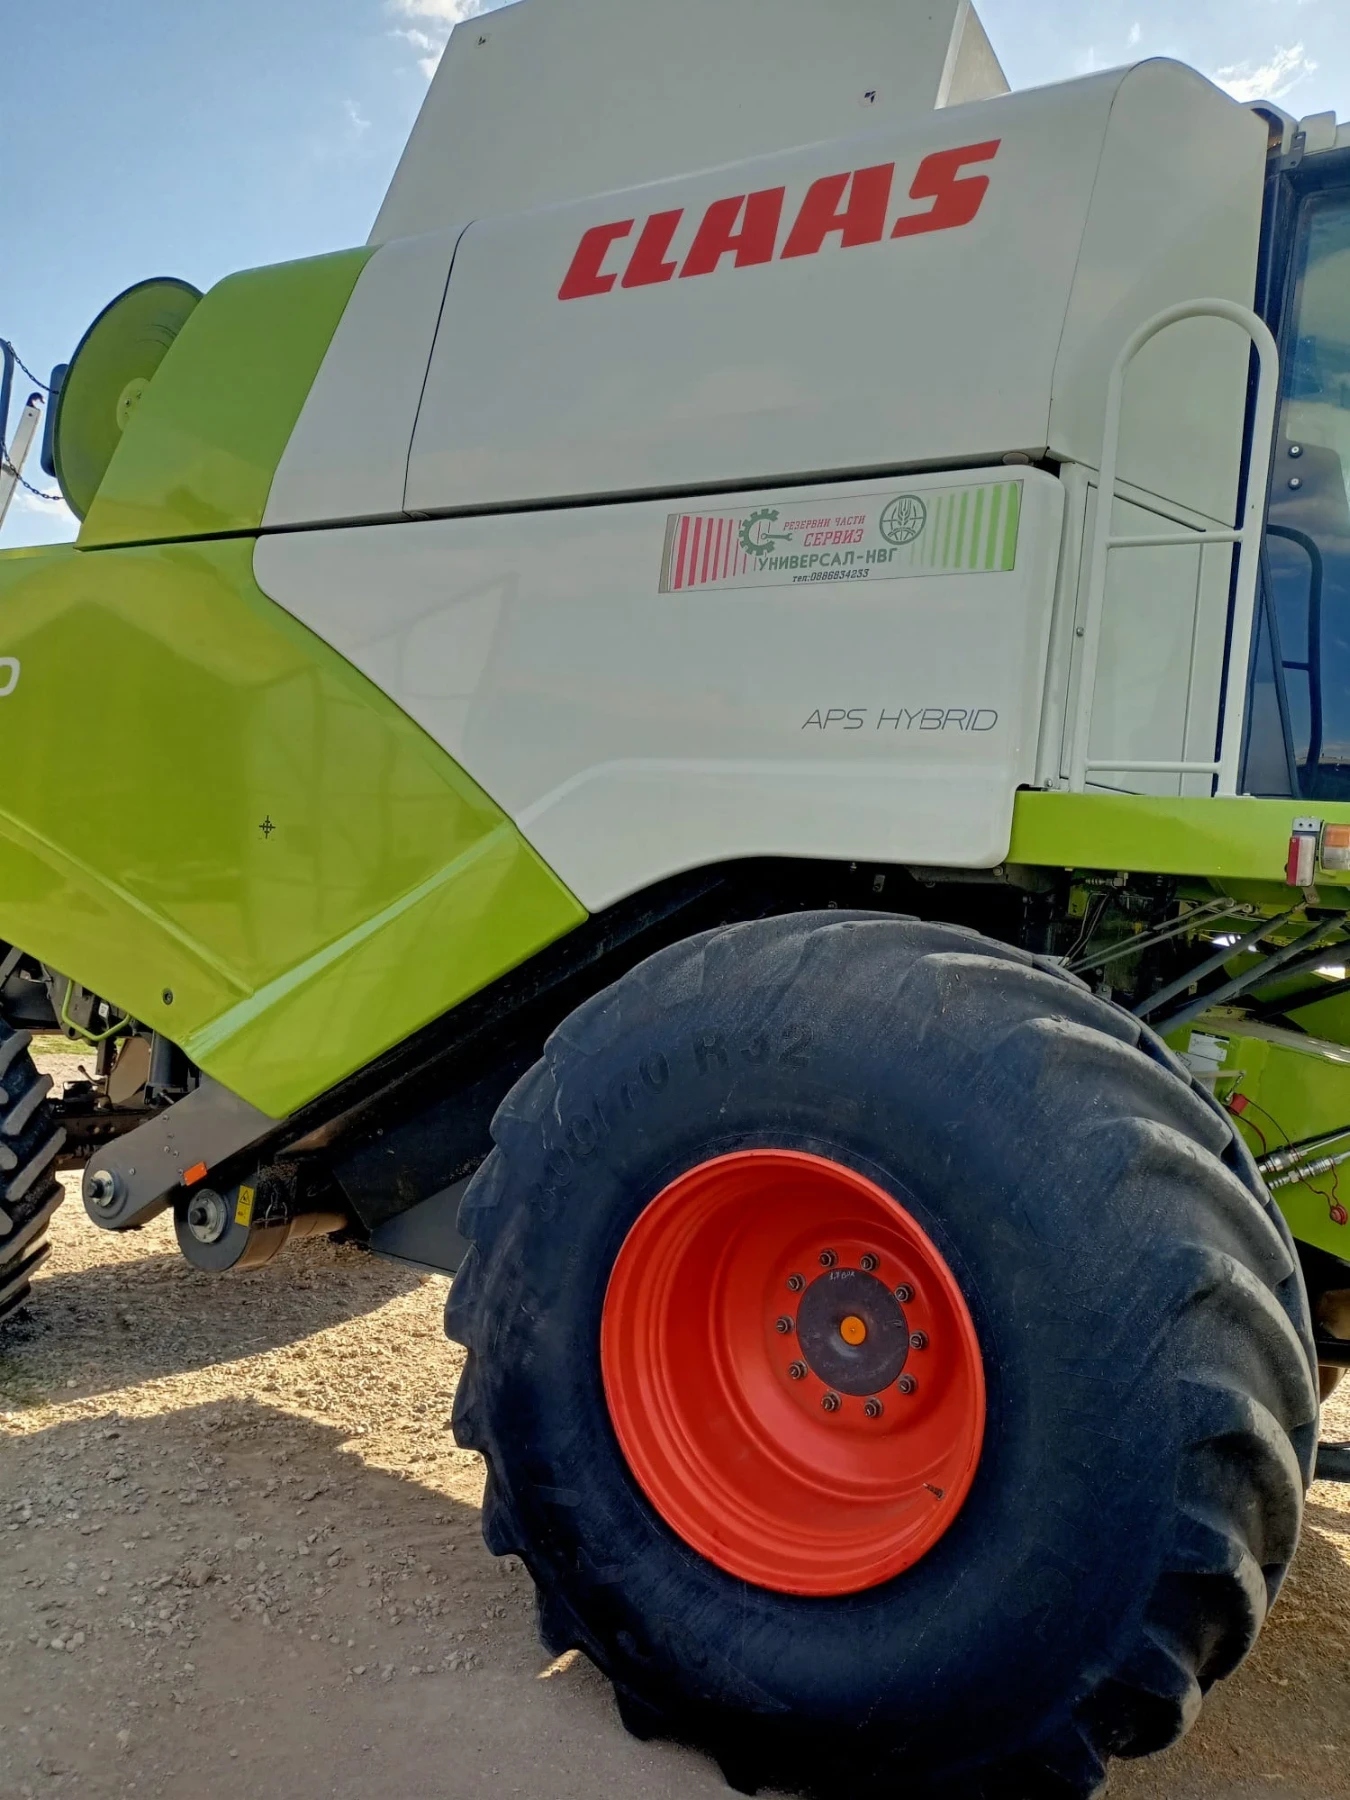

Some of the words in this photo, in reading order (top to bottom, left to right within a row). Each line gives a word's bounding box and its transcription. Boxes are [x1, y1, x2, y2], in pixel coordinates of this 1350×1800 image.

[558, 139, 1002, 301] CLAAS
[783, 518, 831, 531] РЕЗЕРВНИ
[835, 515, 866, 527] ЧАСТИ
[803, 529, 864, 547] СЕРВИЗ
[758, 548, 898, 571] УНИВЕРСАЛ-НВГ
[801, 708, 868, 730] APS
[876, 708, 998, 731] HYBRID
